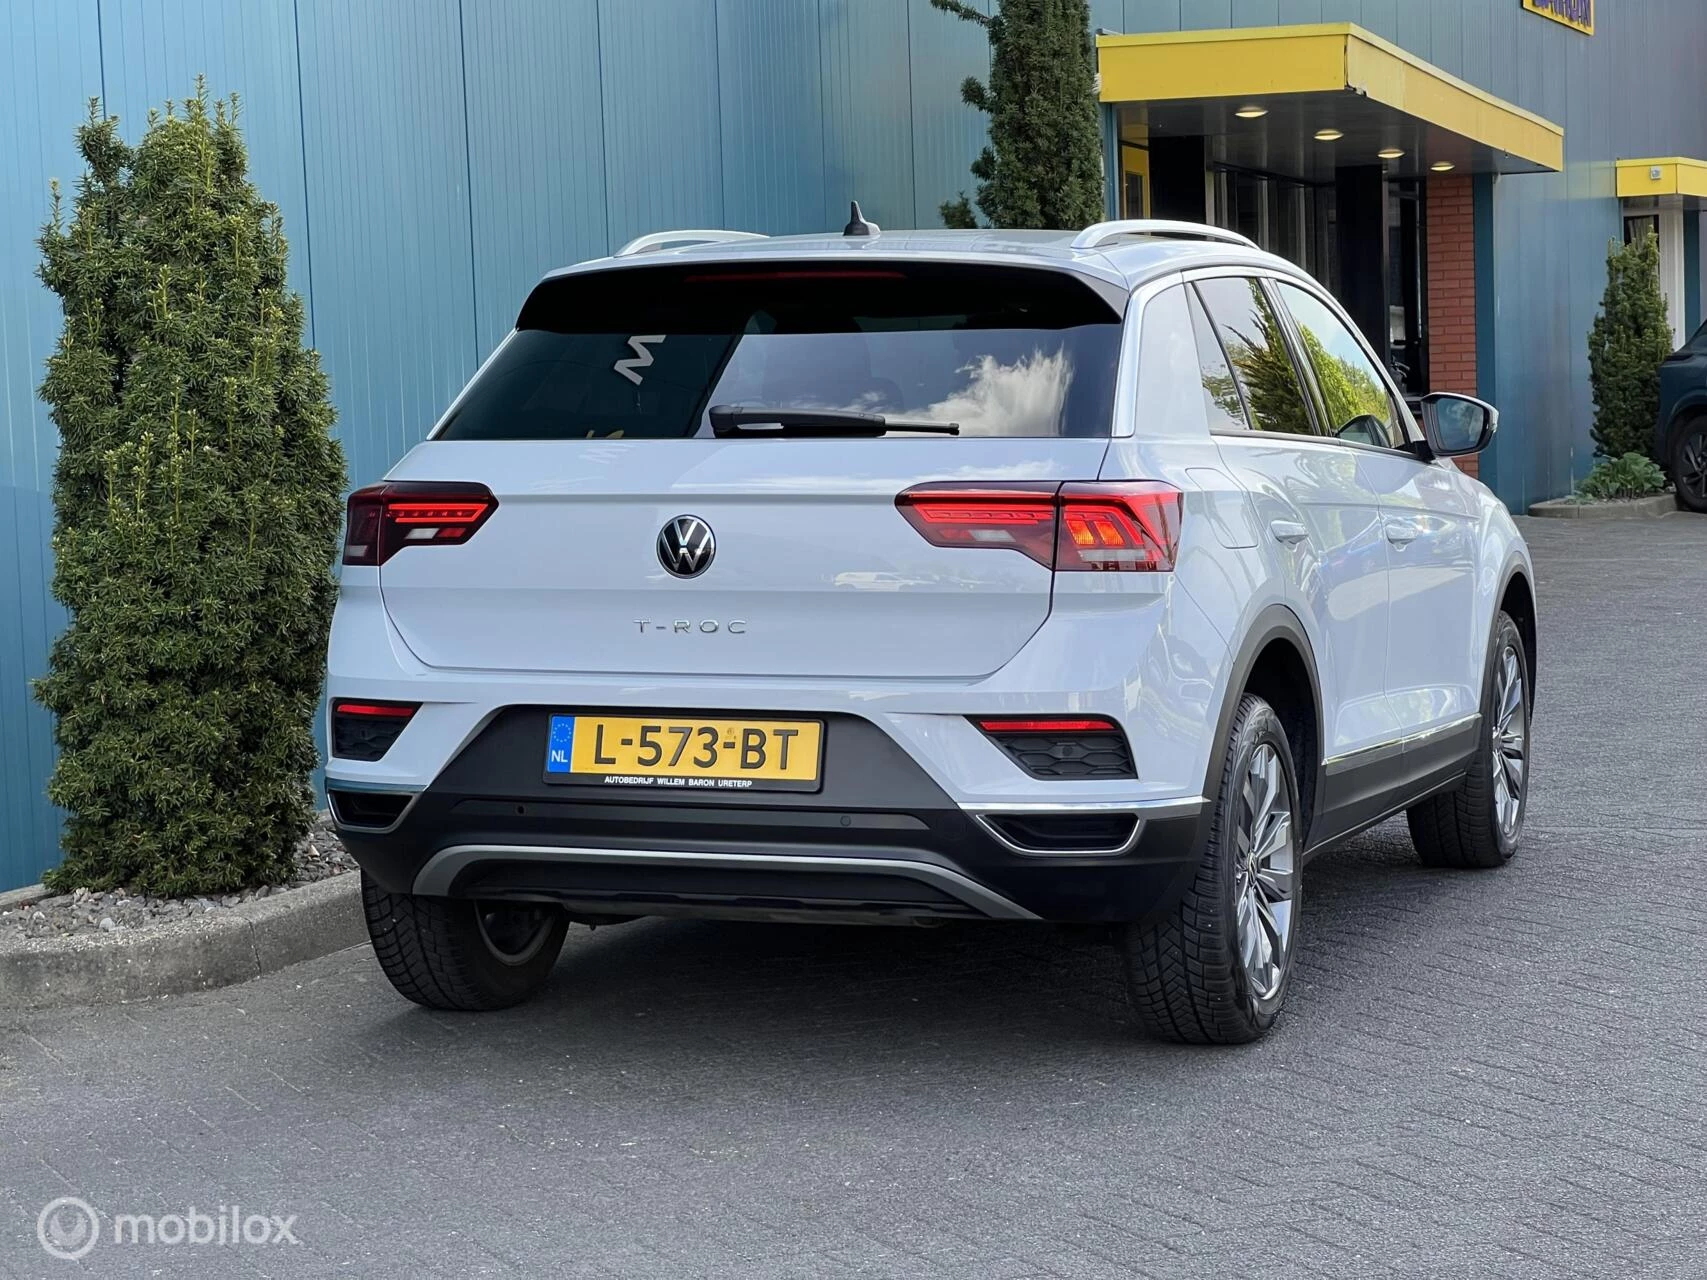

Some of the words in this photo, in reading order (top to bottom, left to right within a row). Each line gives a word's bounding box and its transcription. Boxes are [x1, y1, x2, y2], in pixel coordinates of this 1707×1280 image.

[633, 618, 747, 634] T-ROC
[594, 724, 799, 770] L-573-BT
[551, 749, 568, 763] NL
[604, 775, 654, 785] AUTOBEDRIJF
[657, 777, 685, 786] WILLEM
[688, 778, 715, 787] BARON
[717, 779, 753, 788] URETERP
